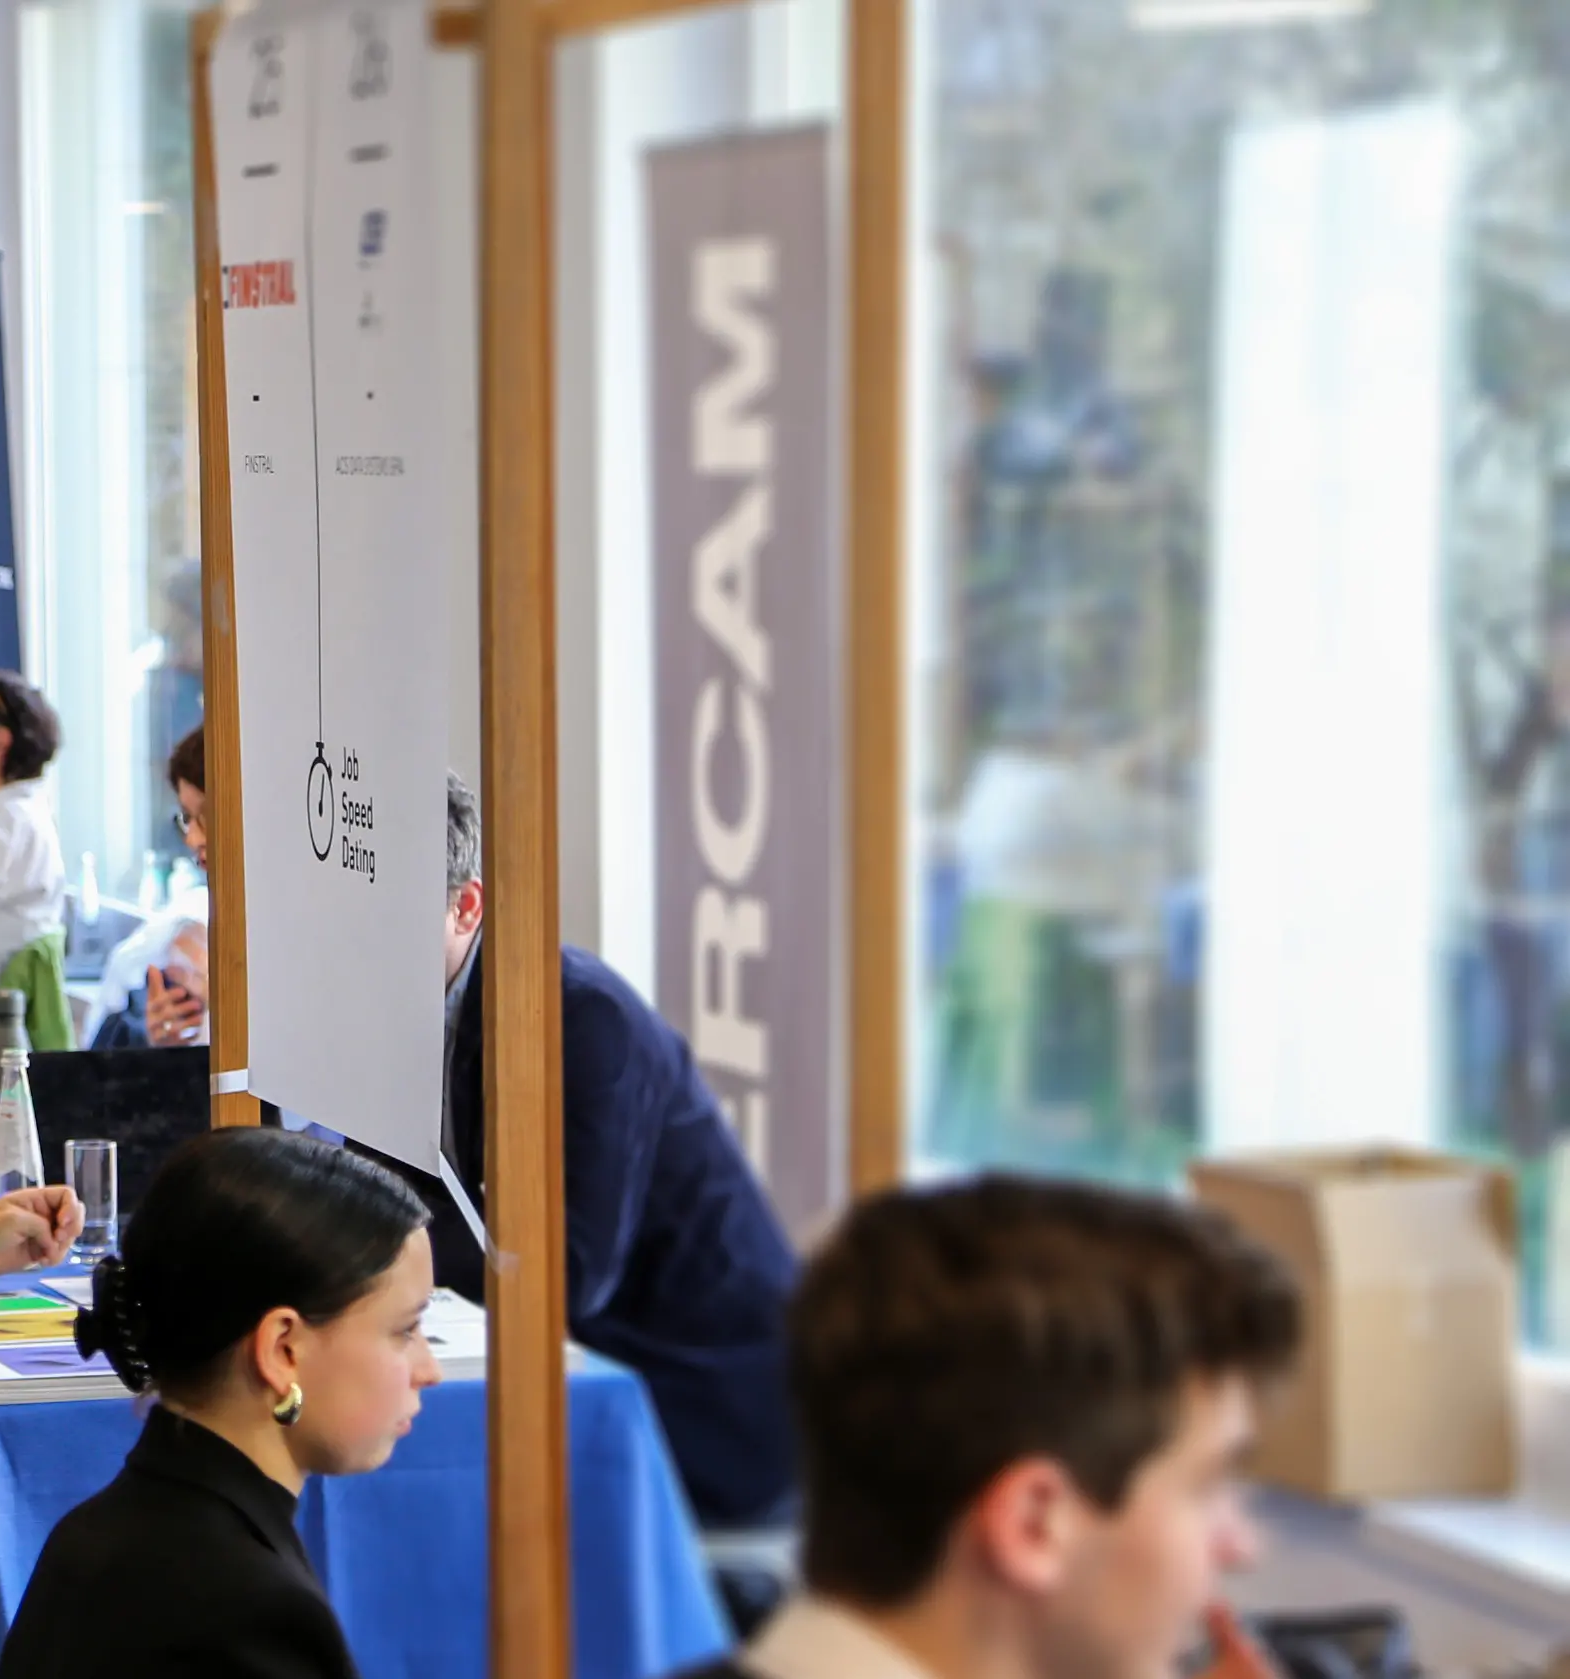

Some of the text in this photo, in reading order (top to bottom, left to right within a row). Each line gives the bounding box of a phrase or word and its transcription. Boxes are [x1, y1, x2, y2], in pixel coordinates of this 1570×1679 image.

[230, 261, 296, 308] FINSTRAL
[245, 454, 274, 474] FINSTRAL
[341, 747, 359, 781] Job
[341, 791, 373, 833] Speed
[341, 835, 376, 884] Dating
